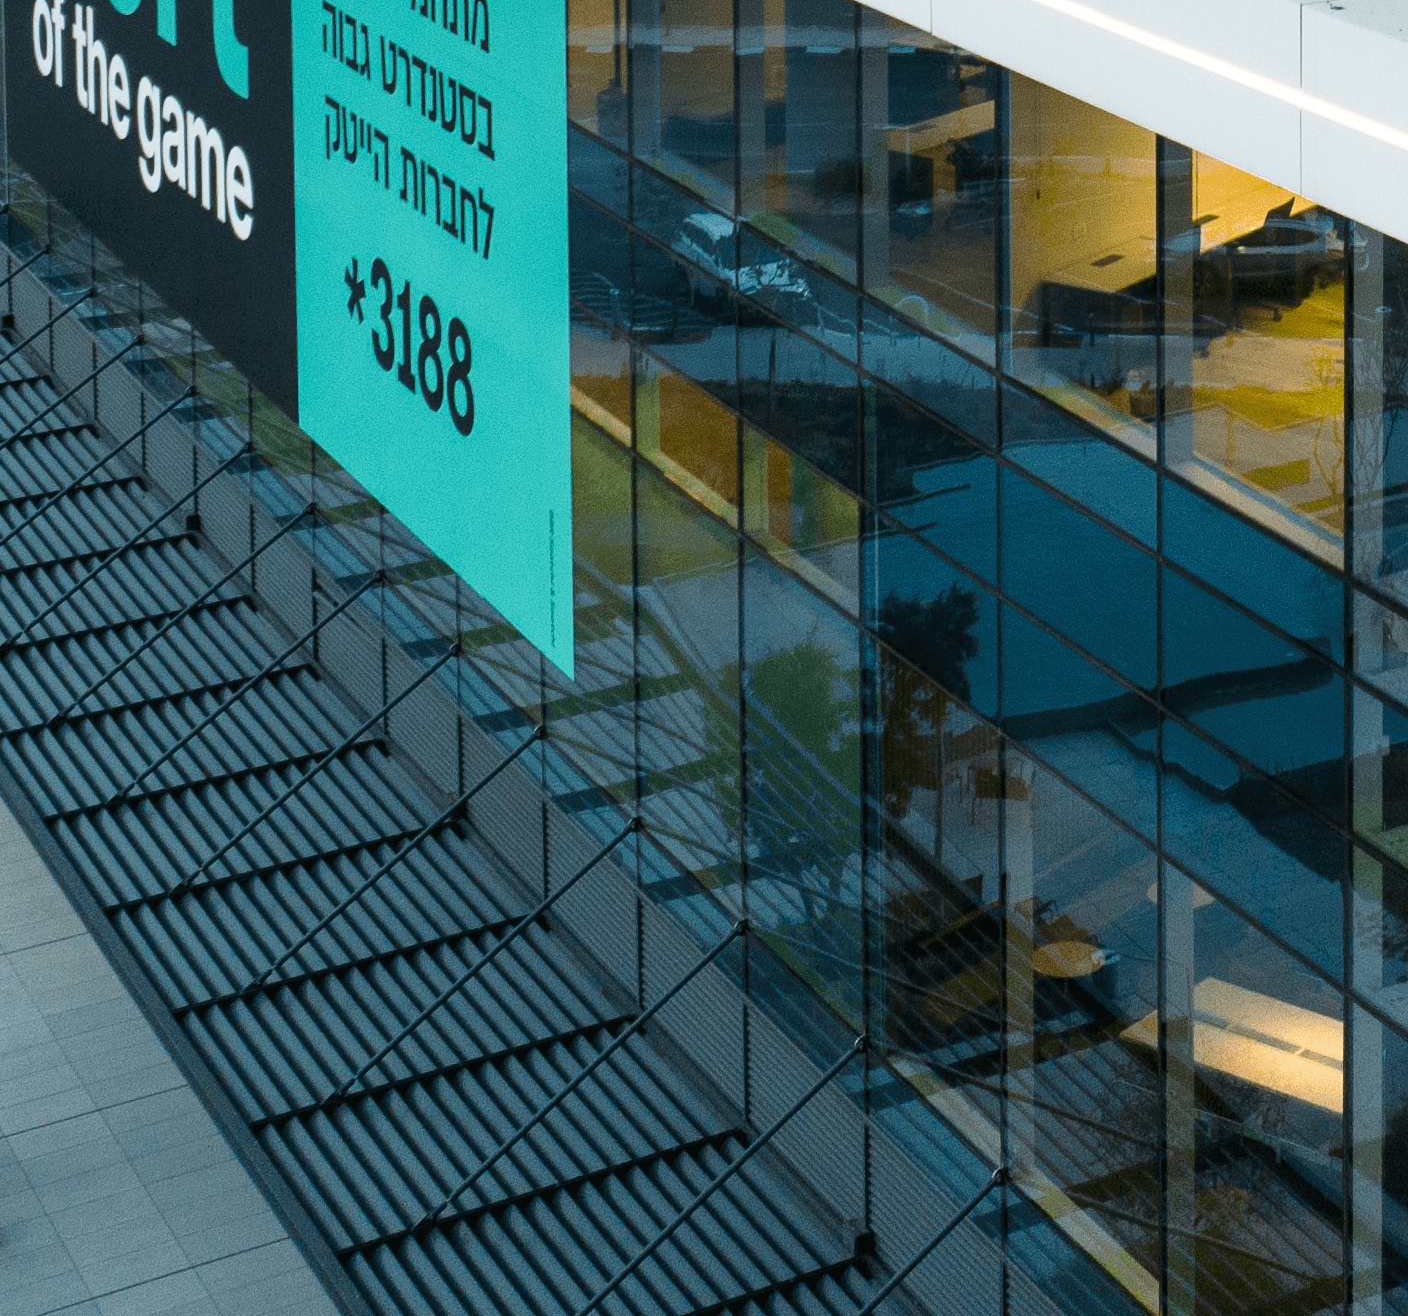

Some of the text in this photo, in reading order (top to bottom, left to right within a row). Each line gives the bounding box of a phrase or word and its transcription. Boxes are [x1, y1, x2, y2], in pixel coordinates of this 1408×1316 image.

[72, 2, 132, 141] the
[136, 75, 254, 241] game
[322, 0, 496, 162] בסטנדרט גבוה
[324, 94, 495, 261] לחברות הייטק
